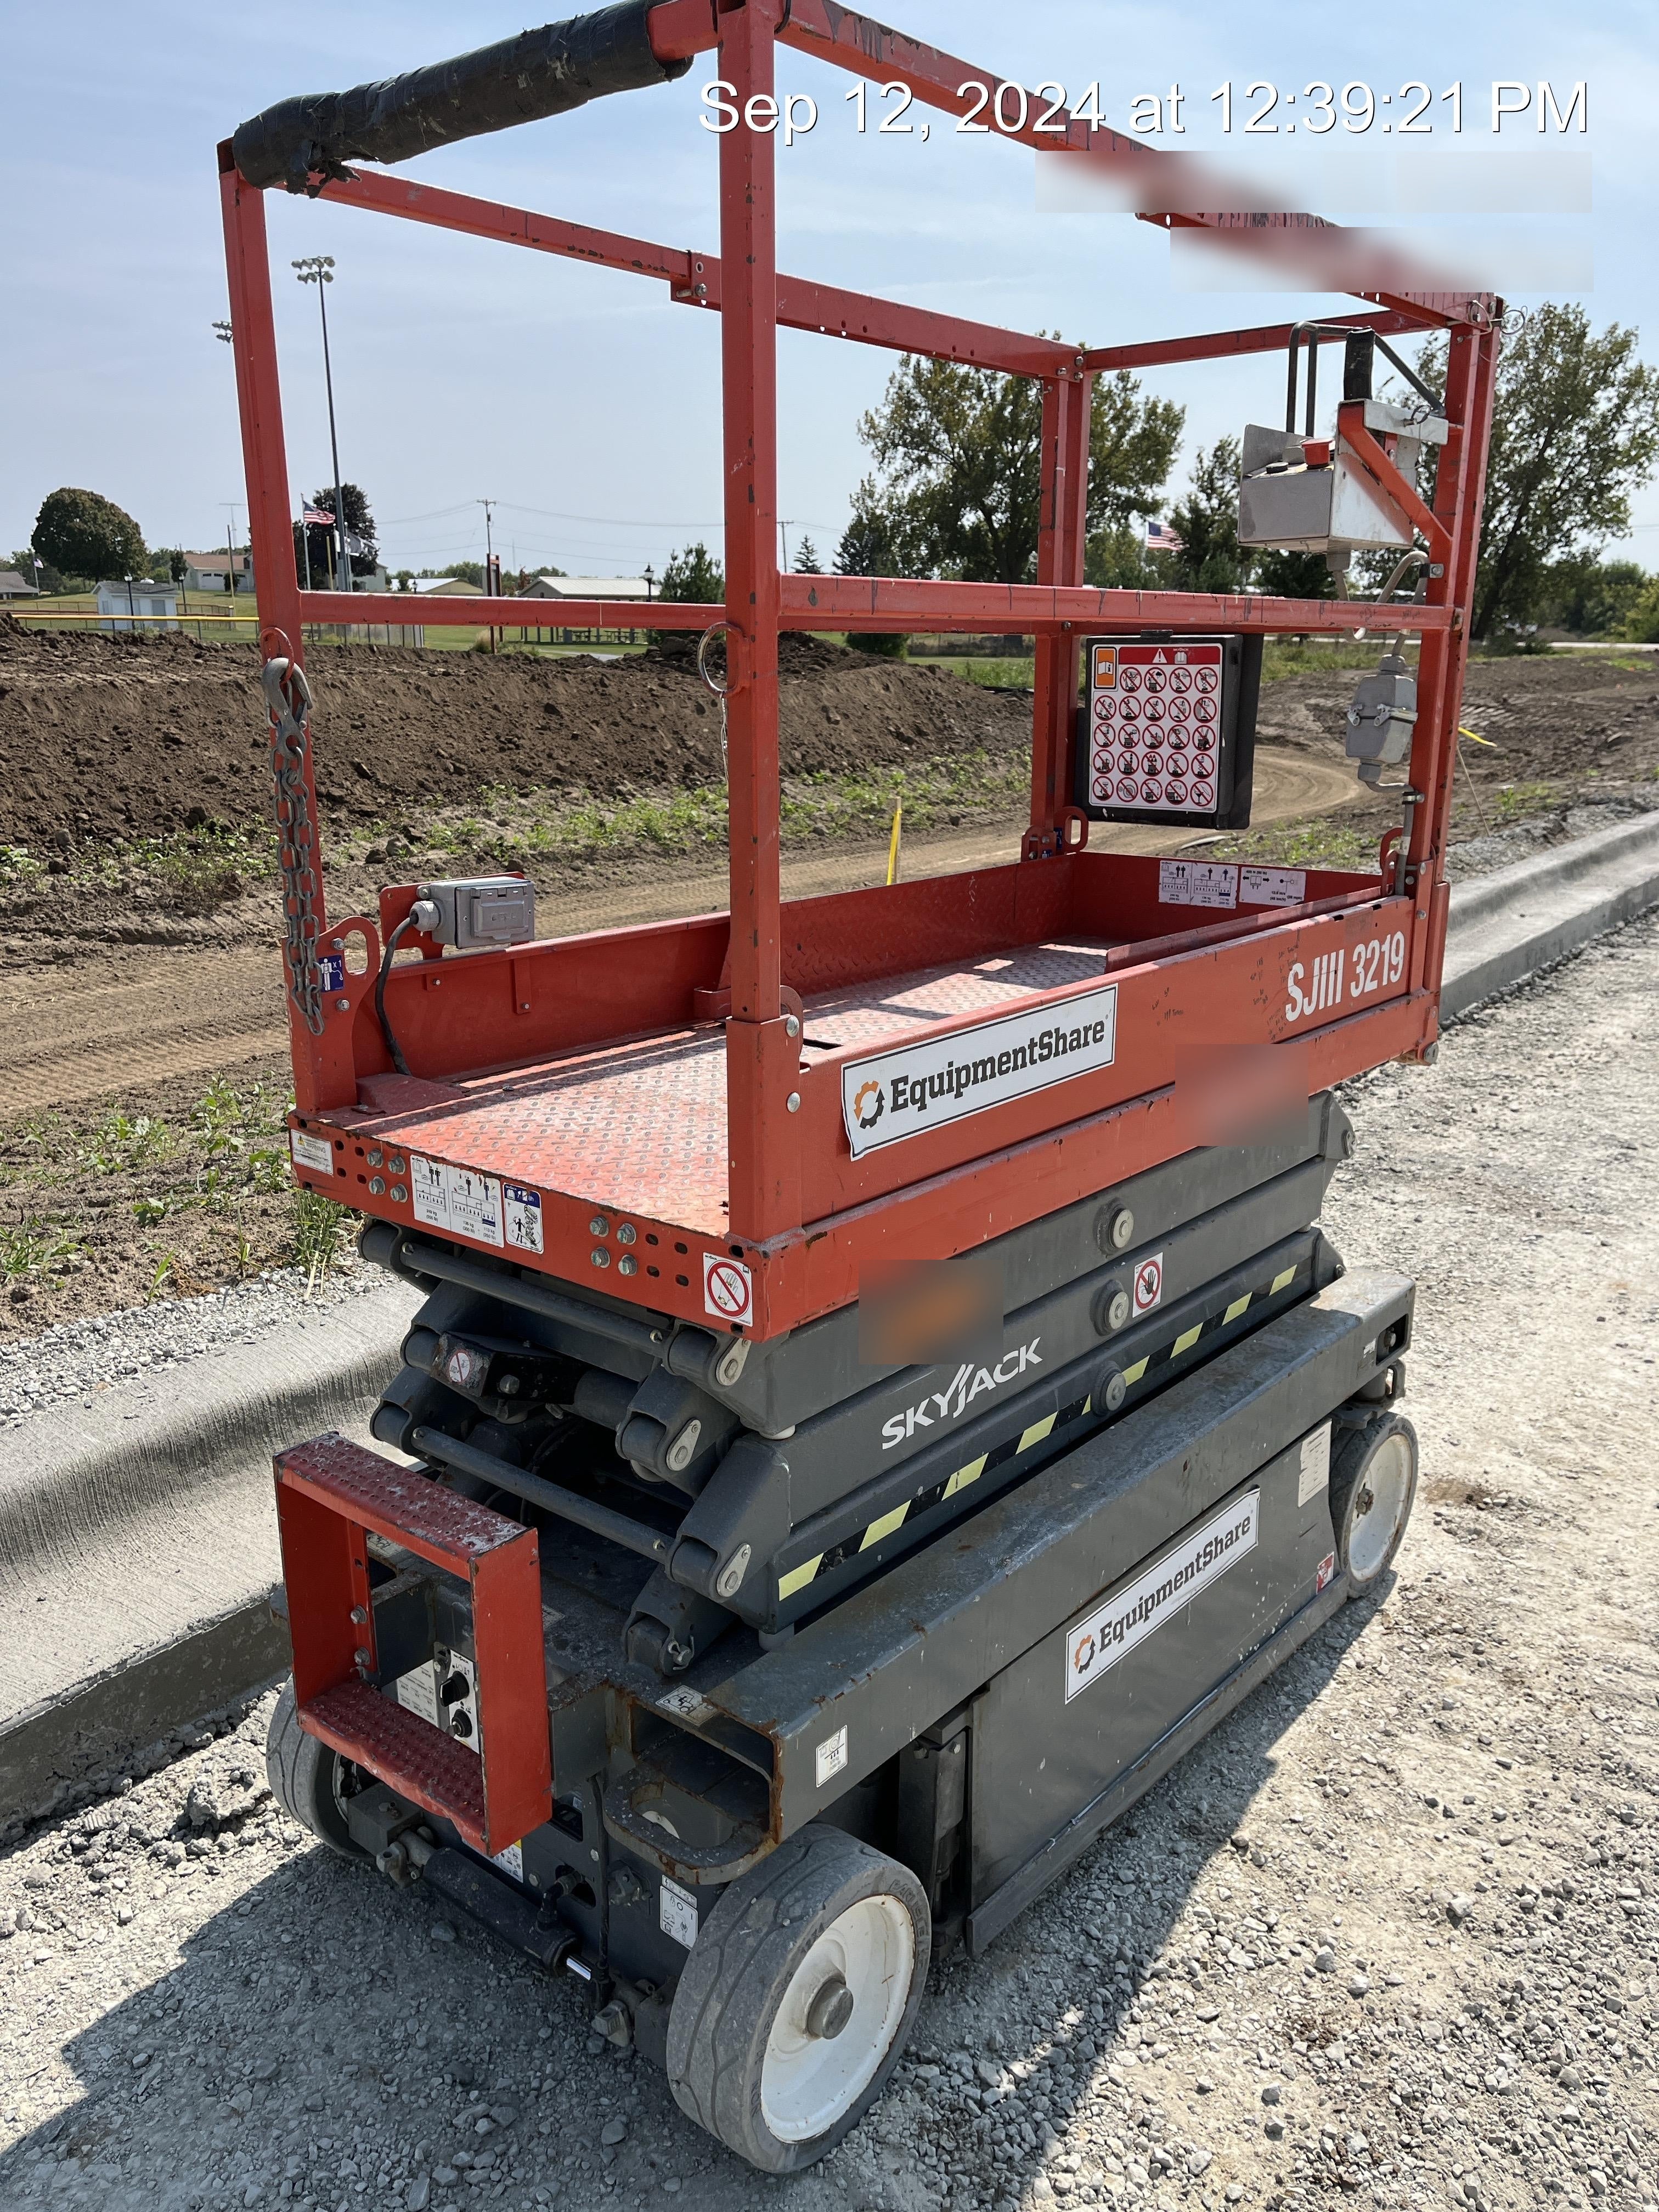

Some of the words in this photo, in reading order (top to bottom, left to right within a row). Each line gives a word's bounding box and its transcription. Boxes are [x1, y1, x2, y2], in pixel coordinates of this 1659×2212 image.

[1350, 930, 1404, 998] 3219
[890, 1020, 1105, 1113] EquipmentShare
[882, 1337, 1043, 1450] SKYJACK
[1099, 1515, 1251, 1653] EquipmentShare
